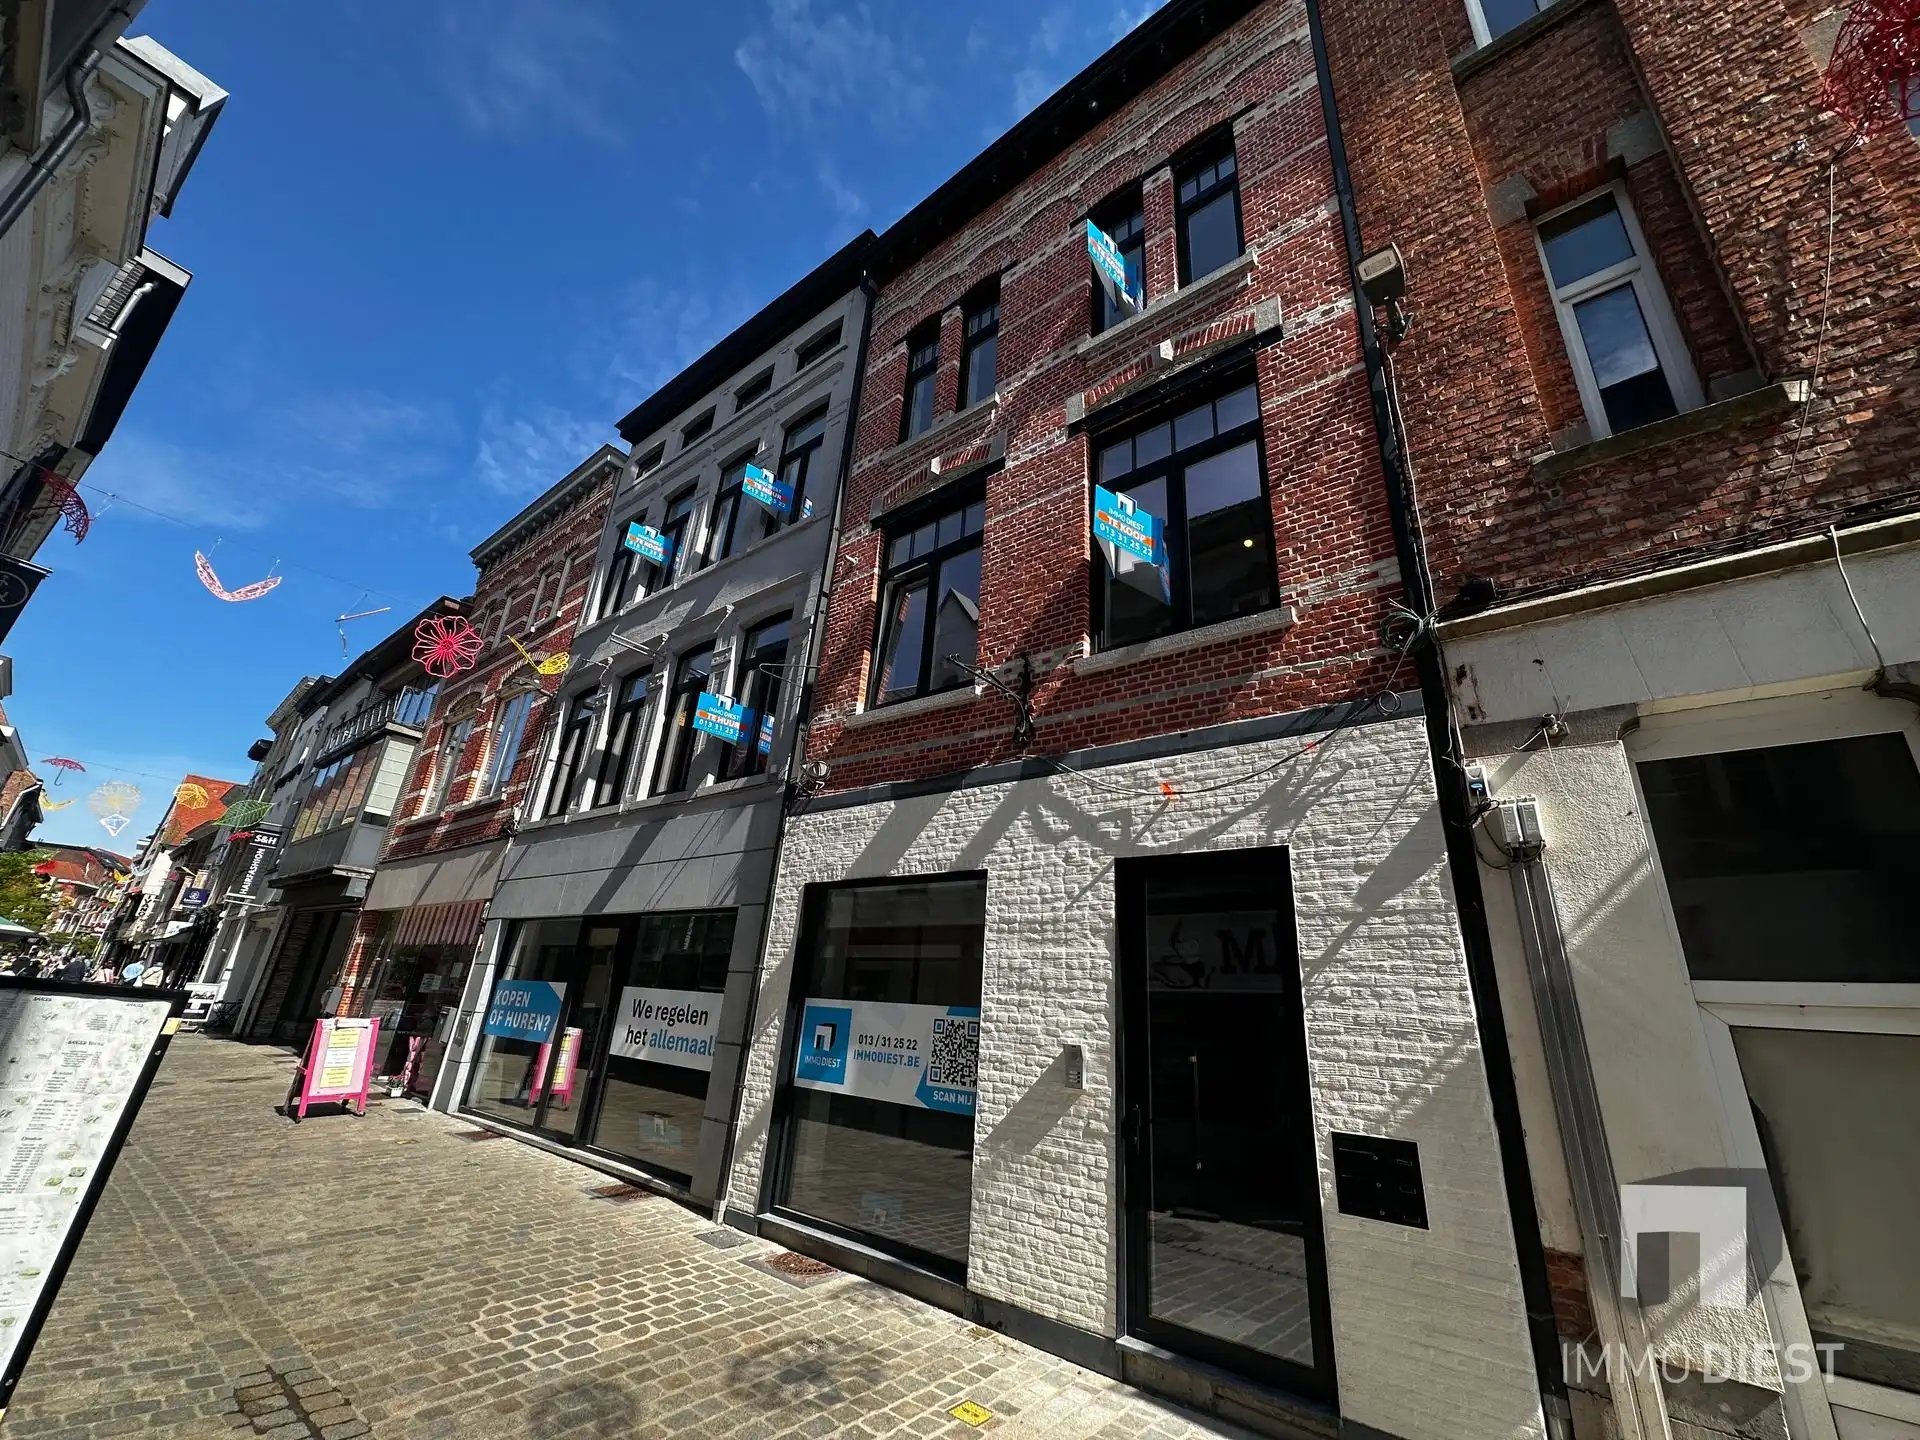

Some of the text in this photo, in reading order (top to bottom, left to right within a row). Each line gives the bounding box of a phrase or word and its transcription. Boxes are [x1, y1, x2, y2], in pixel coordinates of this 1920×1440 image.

[1107, 515, 1147, 542] TE KOOP
[1109, 507, 1145, 532] IMMO DIEST
[1100, 523, 1115, 537] 013
[1118, 532, 1127, 543] 31
[1130, 540, 1140, 549] 25
[1143, 545, 1152, 556] 22
[707, 713, 740, 729] TE HUUR
[709, 707, 740, 720] IMMO DIEST
[699, 718, 712, 728] 013
[715, 723, 723, 731] 31
[254, 834, 277, 845] S&H
[239, 848, 265, 894] HAIRFASHION
[494, 990, 531, 1006] KOPEN
[489, 1010, 551, 1032] OF HUREN?
[631, 998, 709, 1027] We regelen
[625, 1024, 648, 1046] het
[858, 1034, 918, 1050] 013 / 31 25 22
[853, 1050, 920, 1068] IMMODIEST.BE
[933, 1091, 972, 1105] SCAN MIJ
